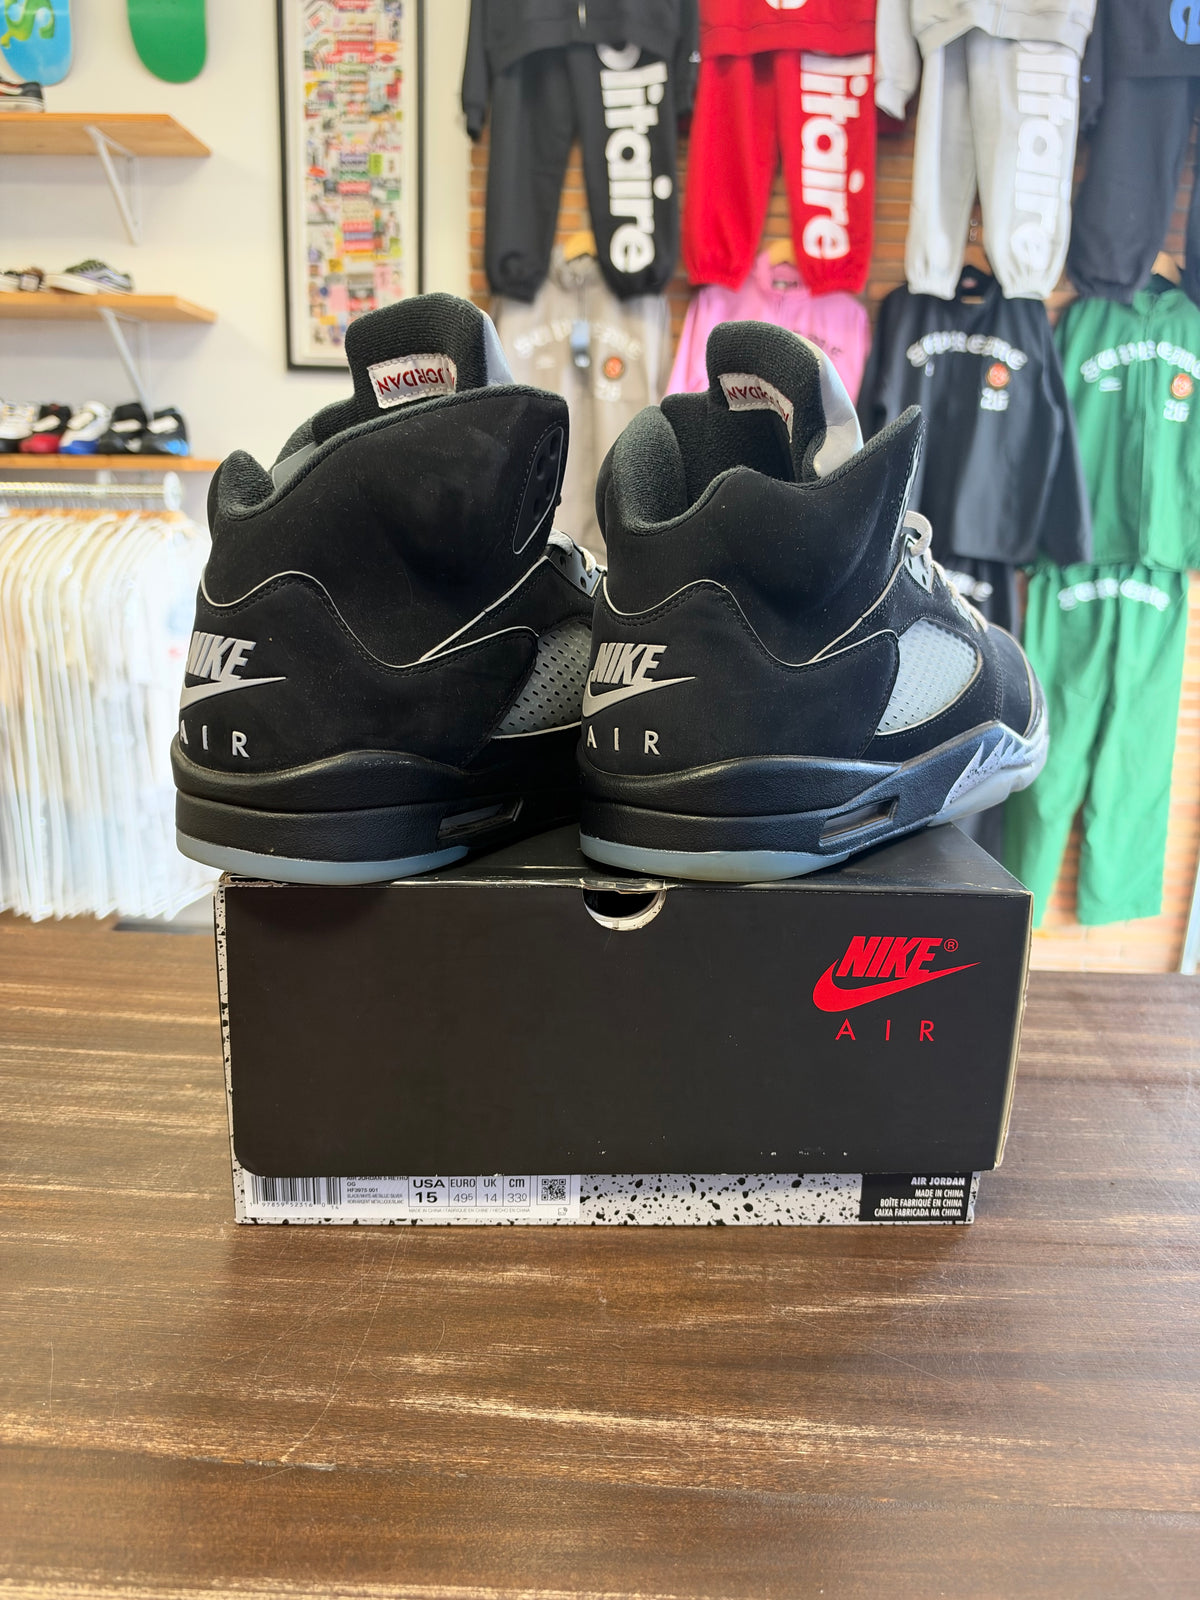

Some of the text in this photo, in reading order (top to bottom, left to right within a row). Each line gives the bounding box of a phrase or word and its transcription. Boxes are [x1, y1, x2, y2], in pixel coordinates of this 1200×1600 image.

[376, 367, 445, 395] JORDAN
[590, 642, 668, 685] NIKE
[179, 719, 250, 758] AIR
[586, 724, 660, 756] AIR
[835, 1017, 935, 1042] AIR
[413, 1178, 445, 1188] USA
[450, 1178, 476, 1188] EURO
[484, 1178, 497, 1188] UK
[508, 1178, 525, 1188] cm
[910, 1177, 965, 1186] AIR JORDAN
[415, 1192, 438, 1203] 15
[485, 1192, 497, 1203] 14
[914, 1189, 964, 1197] MADE IN CHINA
[933, 1199, 941, 1207] EN
[942, 1199, 962, 1207] CHINA
[874, 1208, 893, 1217] CAIXA
[894, 1208, 930, 1217] FABRICADA
[941, 1208, 961, 1217] CHINA
